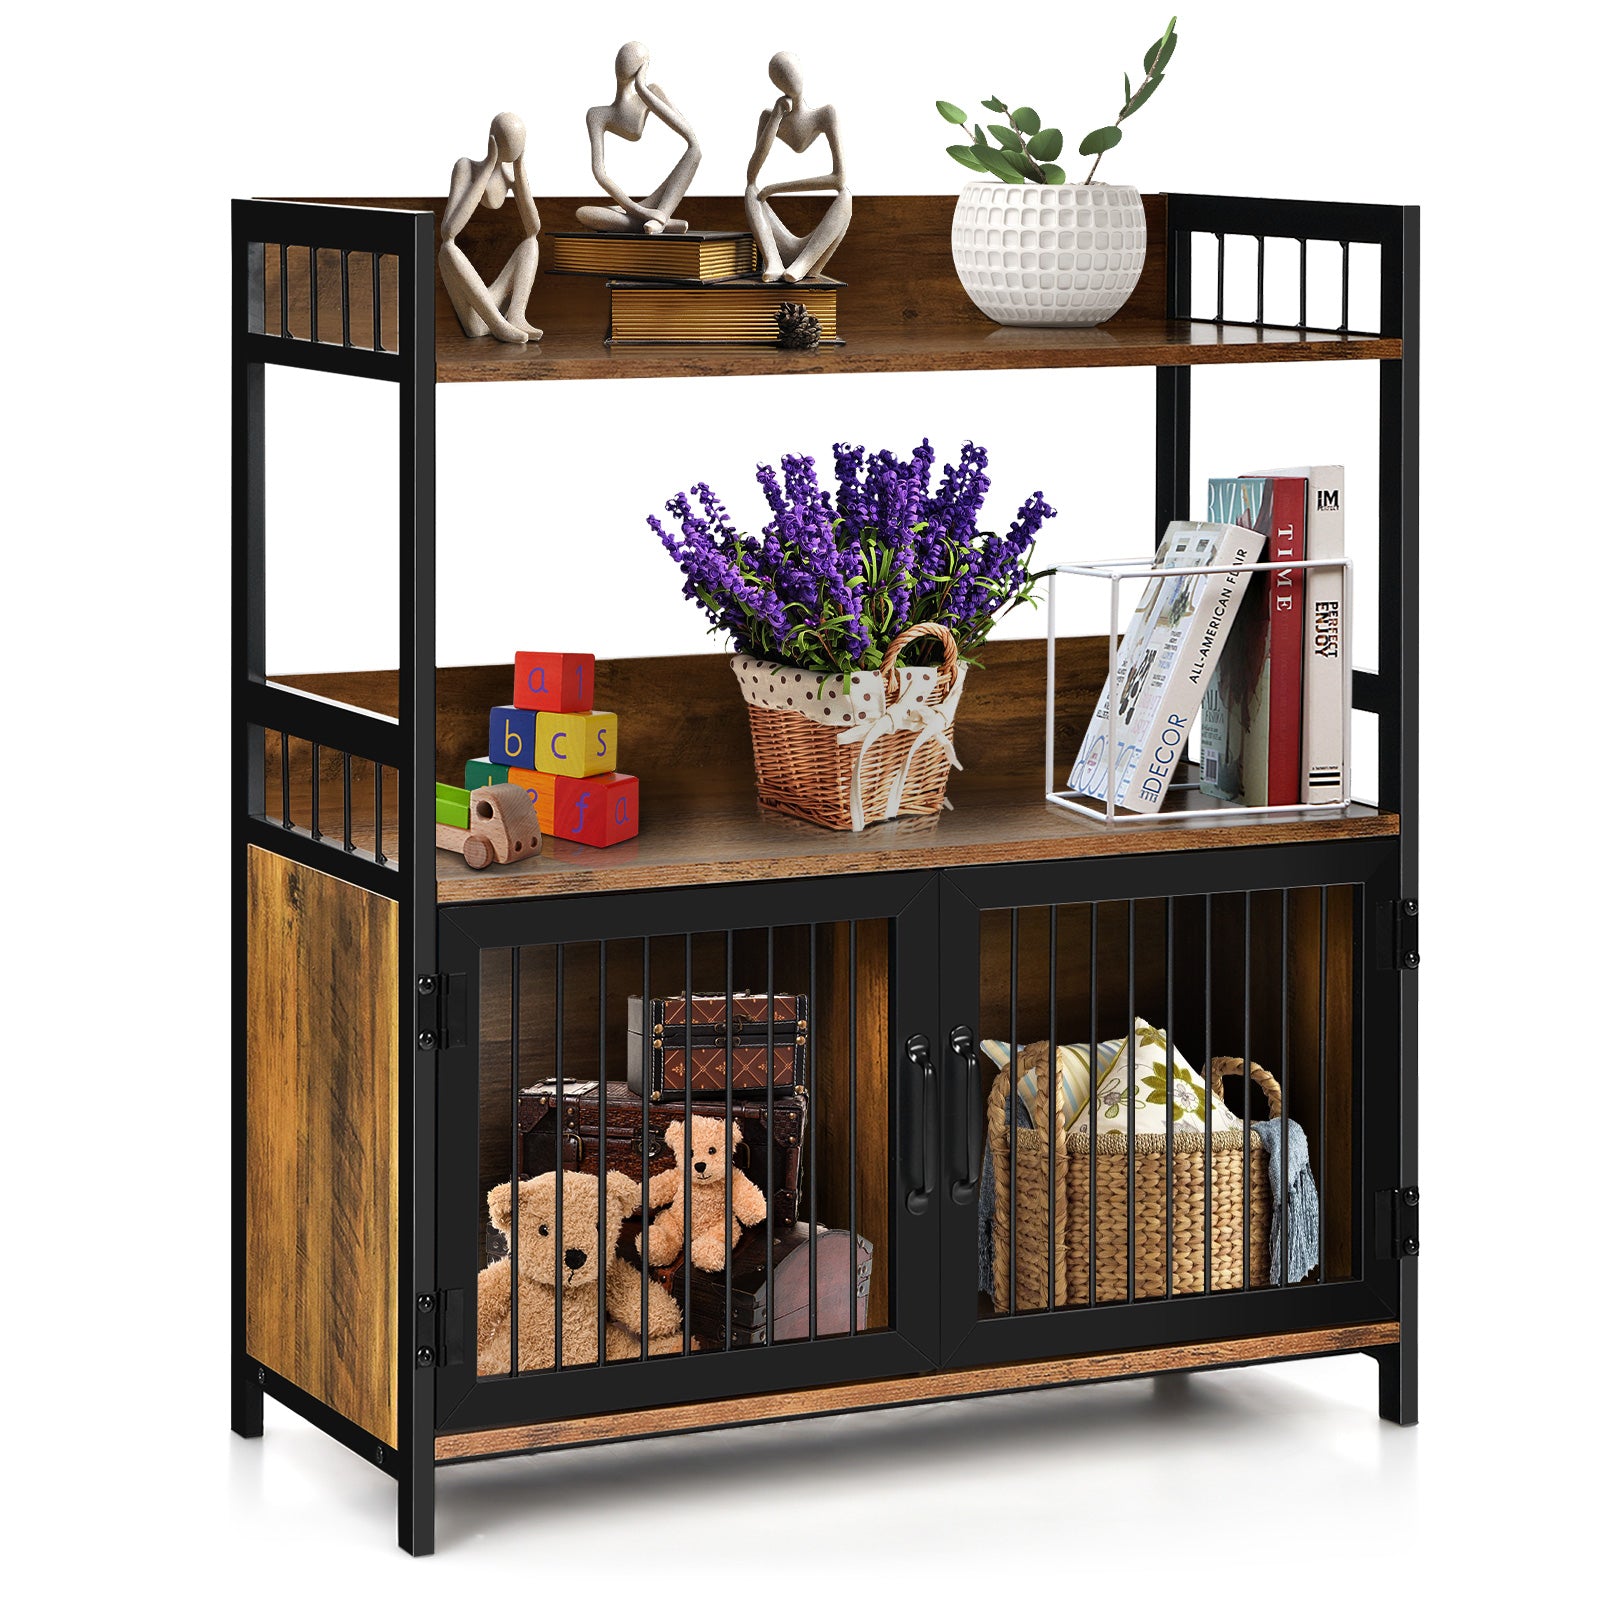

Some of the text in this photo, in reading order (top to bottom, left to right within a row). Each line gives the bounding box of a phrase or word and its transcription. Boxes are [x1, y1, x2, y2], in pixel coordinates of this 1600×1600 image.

[1317, 490, 1339, 507] IM
[1276, 524, 1294, 611] TIME
[1189, 587, 1233, 684] ALL-AMERICAN
[1315, 601, 1329, 658] ENJOY
[1328, 601, 1339, 658] PERFECT
[528, 667, 549, 694] a
[575, 665, 583, 701] 1
[505, 718, 523, 757] b
[551, 732, 567, 760] c
[596, 728, 607, 757] s
[1142, 713, 1188, 793] DECOR
[572, 791, 591, 833] f
[615, 796, 630, 826] a
[1139, 789, 1158, 803] ELLE
